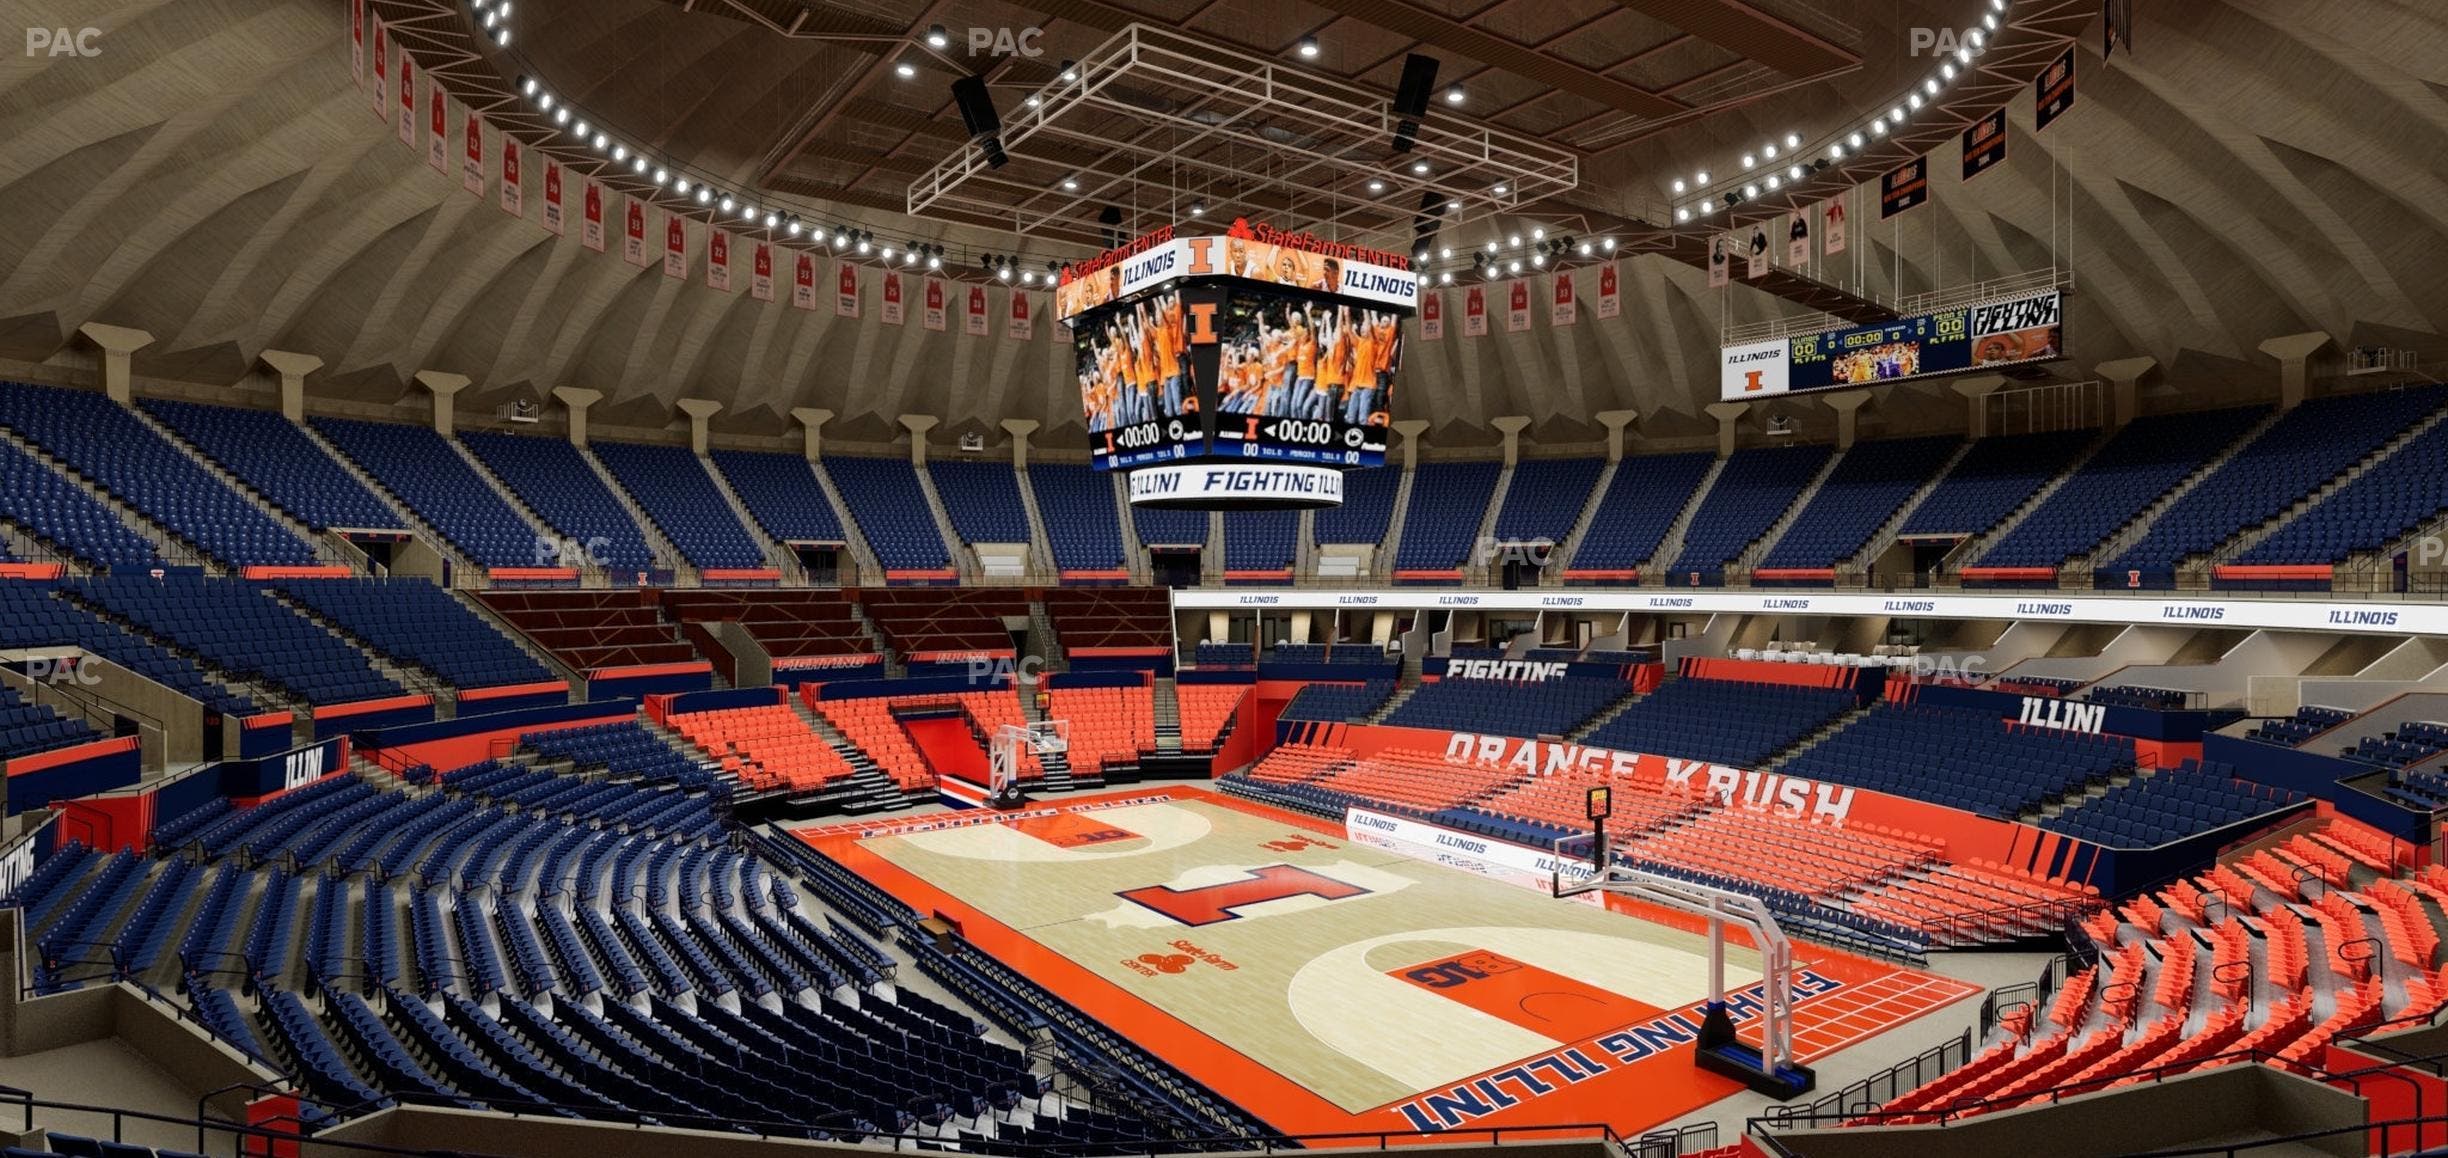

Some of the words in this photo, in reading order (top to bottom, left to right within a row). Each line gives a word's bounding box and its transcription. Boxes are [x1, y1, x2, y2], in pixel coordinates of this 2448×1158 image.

[1124, 250, 1176, 287] ILLINOIS
[1345, 270, 1416, 298] ILLINOIS
[1974, 294, 2058, 325] FIGHTING
[1847, 332, 1881, 346] 00:00
[1939, 320, 1963, 334] 00
[1728, 349, 1782, 364] ILLINOIS
[1794, 343, 1814, 357] 00
[1125, 422, 1160, 448] 00:00
[1279, 419, 1331, 444] 00:00
[1108, 455, 1119, 468] 00
[1173, 444, 1186, 458] 00
[1243, 443, 1258, 457] 00
[1345, 451, 1359, 464] 00
[1137, 472, 1181, 496] ILLINI
[1204, 471, 1315, 493] FIGHTING
[1240, 595, 1280, 604] ILLINOIS
[1339, 595, 1378, 604] ILLINOIS
[1439, 596, 1479, 605] ILLINOIS
[1542, 596, 1583, 606] ILLINOIS
[1649, 597, 1693, 607] ILLINOIS
[1763, 599, 1809, 609] ILLINOIS
[1884, 601, 1935, 612] ILLINOIS
[2017, 603, 2073, 615] ILLINOIS
[2163, 606, 2225, 620] ILLINOIS
[2329, 610, 2399, 626] ILLINOIS
[777, 655, 866, 672] FIGHTING
[1447, 659, 1569, 682] FIGHTING
[2019, 696, 2107, 735] ILLINI
[284, 746, 324, 791] ILLINI
[1443, 732, 1641, 779] ORANGE
[1662, 757, 1857, 828] KRUSH
[1353, 813, 1398, 833] ILLINOIS
[1436, 833, 1488, 855] ILLINOIS
[1535, 857, 1596, 880] ILLINOIS
[1397, 1048, 1610, 1137] ILLINI
